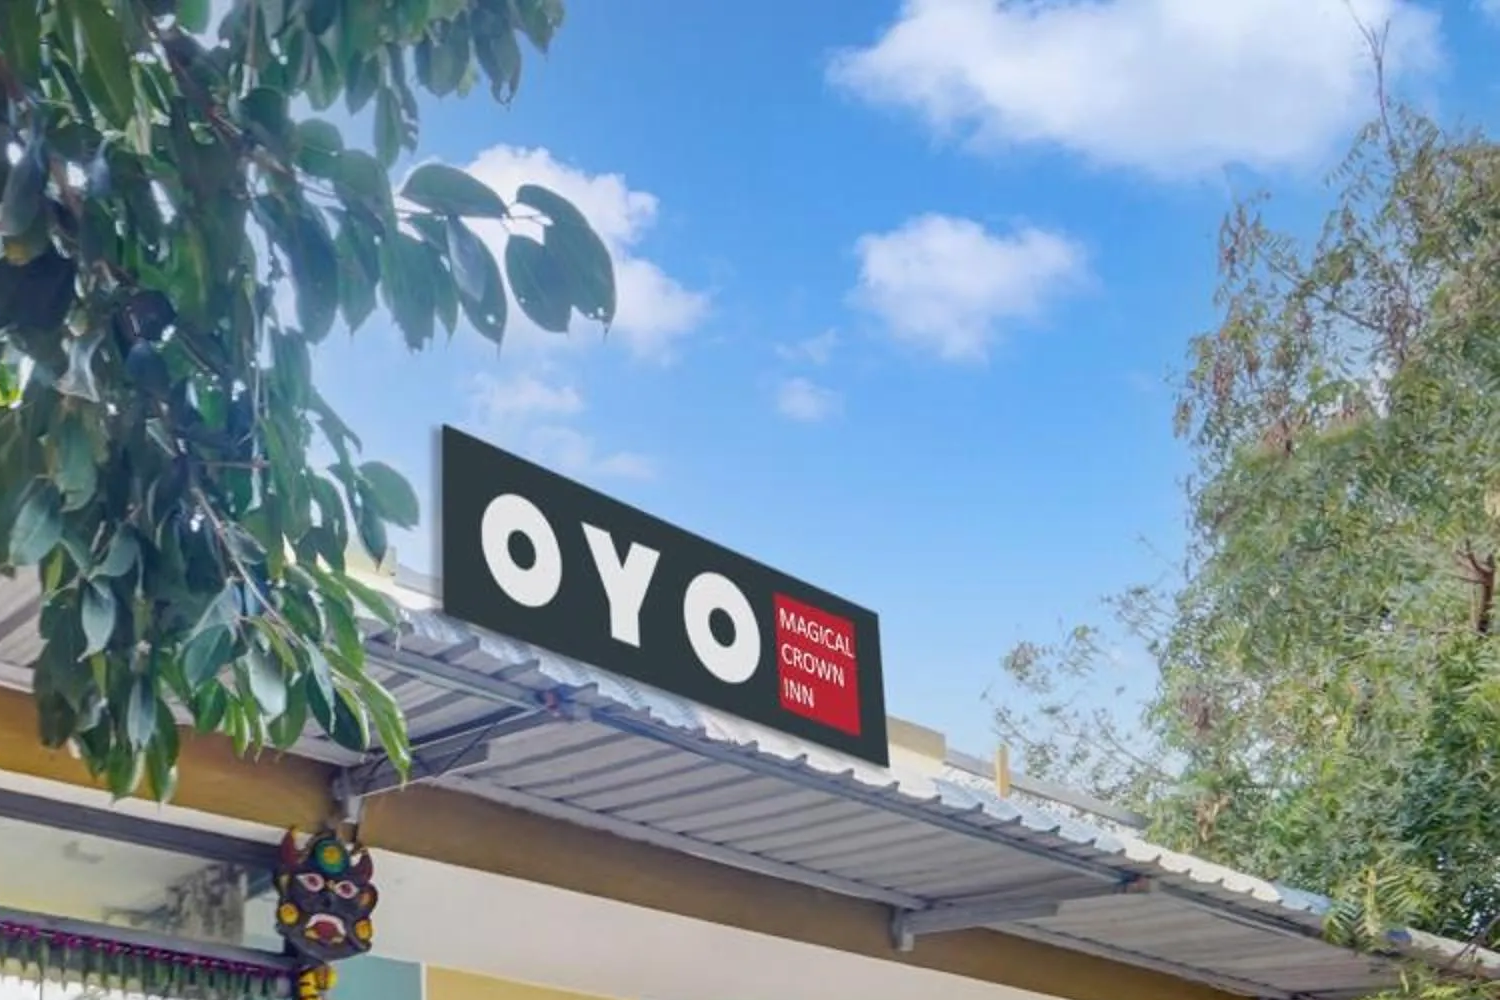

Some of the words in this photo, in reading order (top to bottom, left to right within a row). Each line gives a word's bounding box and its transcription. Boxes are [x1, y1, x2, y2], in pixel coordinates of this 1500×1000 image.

[481, 493, 761, 684] OYO
[779, 607, 856, 659] MAGICAL
[781, 643, 845, 688] CROWN
[783, 677, 815, 708] INN
